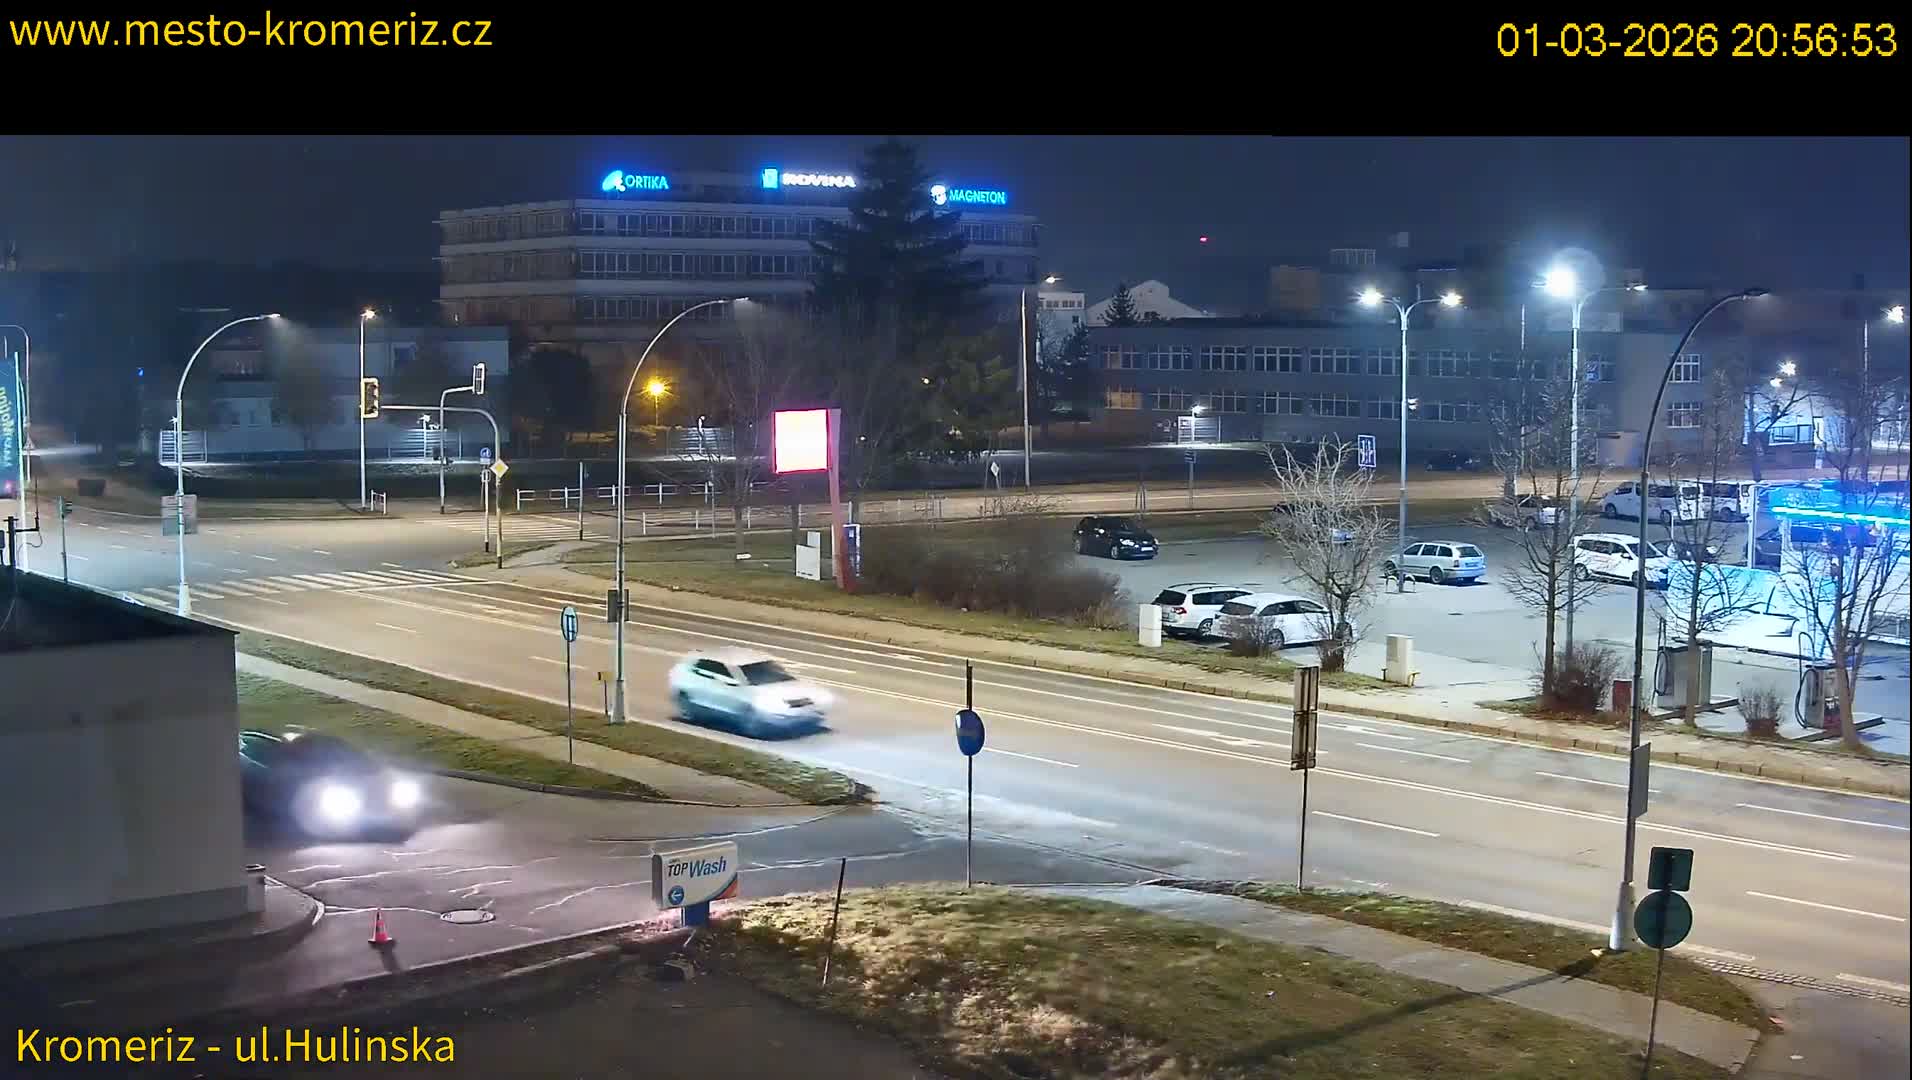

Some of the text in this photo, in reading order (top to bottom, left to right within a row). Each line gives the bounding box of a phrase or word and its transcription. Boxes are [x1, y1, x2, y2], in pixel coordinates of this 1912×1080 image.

[625, 175, 669, 189] ORTIKA
[949, 189, 1006, 205] MAGNETON
[668, 855, 727, 878] TOP Wash
